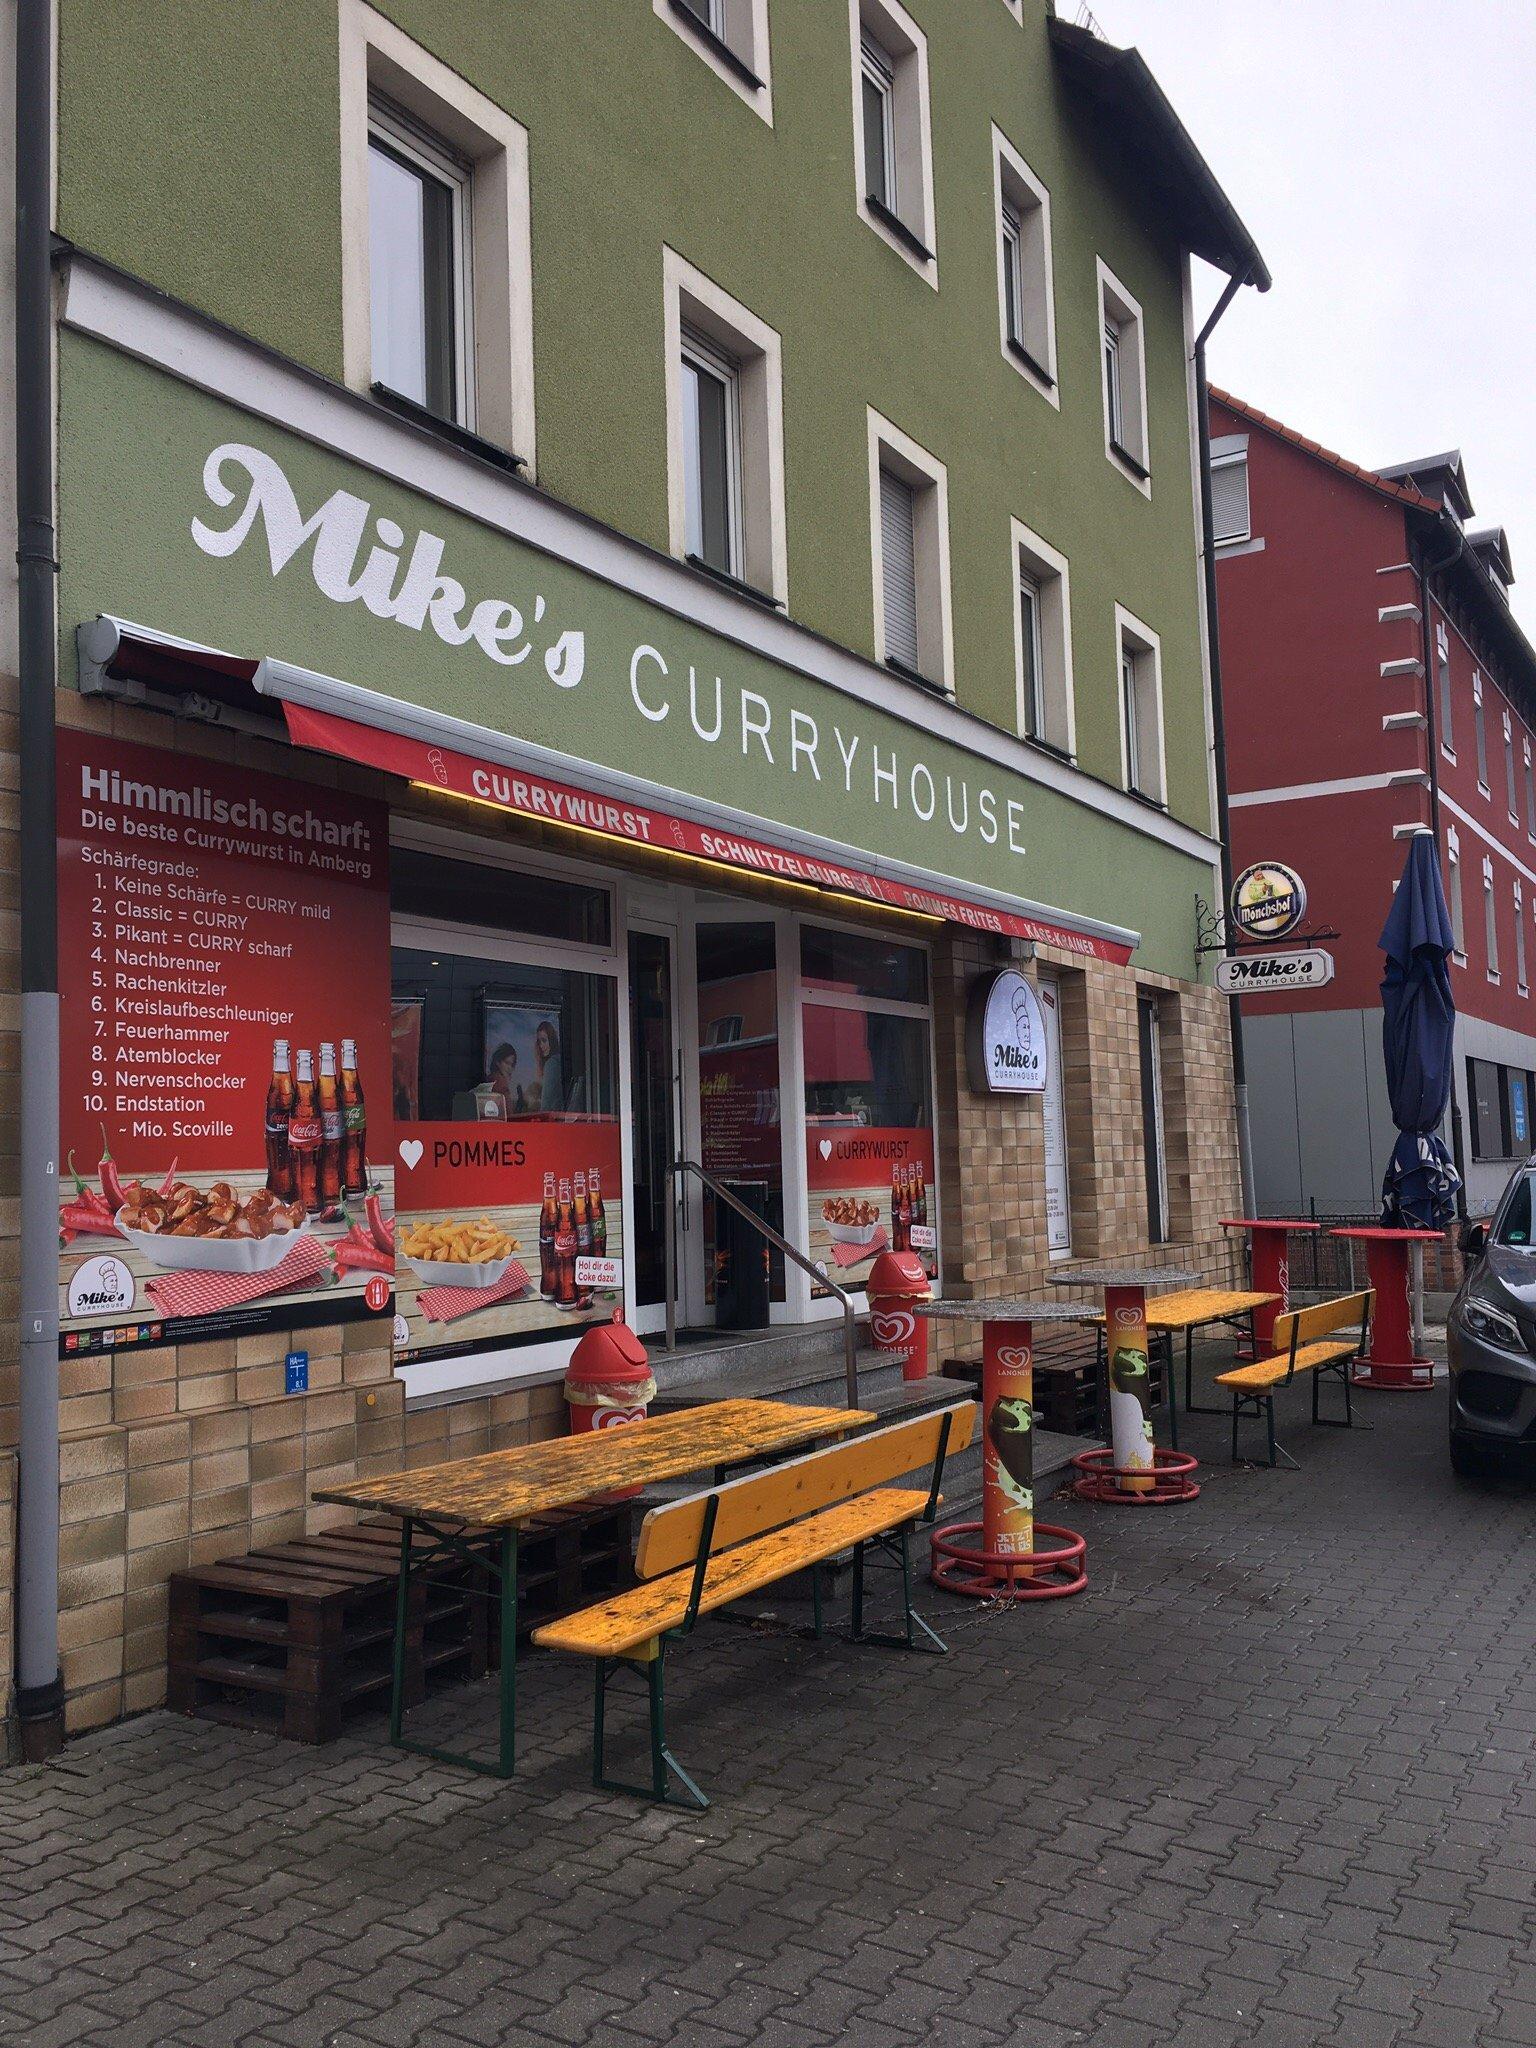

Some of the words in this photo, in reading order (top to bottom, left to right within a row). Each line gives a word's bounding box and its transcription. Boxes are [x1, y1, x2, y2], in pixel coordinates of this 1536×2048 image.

[191, 443, 585, 688] Mike's
[630, 644, 1026, 855] CURRYHOUSE
[81, 765, 268, 832] Himmlisch
[272, 810, 371, 851] scharf:
[81, 808, 117, 832] Die
[123, 815, 178, 842] beste
[184, 827, 283, 861] Currywurst
[288, 846, 303, 864] in
[308, 850, 371, 878] Amberg
[81, 846, 199, 879] Schärfegrade:
[472, 769, 651, 840] CURRYWURST
[700, 832, 875, 896] SCHNITZELBURGER
[903, 891, 958, 921] POMMES
[959, 907, 1002, 932] FRITES
[1023, 922, 1096, 956] KÄSE-KRAINER
[95, 873, 106, 889] 1.
[115, 876, 162, 897] Keine
[167, 883, 227, 906] Schärfe
[245, 894, 297, 915] CURRY
[301, 904, 331, 920] mild
[91, 897, 107, 914] 2.
[115, 900, 173, 921] Classic
[193, 910, 248, 930] CURRY
[91, 922, 107, 938] 3.
[115, 924, 168, 945] Pikant
[188, 933, 243, 954] CURRY
[248, 940, 293, 958] scharf
[91, 946, 107, 962] 4.
[115, 948, 221, 973] Nachbrenner
[1229, 959, 1313, 980] Mike's
[91, 971, 107, 987] 5.
[115, 973, 227, 997] Rachenkitzler
[1230, 975, 1312, 988] CURRYHOUSE
[91, 996, 107, 1012] 6.
[115, 998, 294, 1025] Kreislaufbeschleuniger
[94, 1021, 107, 1037] 7.
[115, 1022, 230, 1043] Feuerhammer
[91, 1046, 107, 1062] 8.
[115, 1046, 221, 1065] Atemblocker
[993, 1044, 1039, 1069] Mike's
[92, 1070, 108, 1086] 9.
[115, 1071, 246, 1089] Nervenschocker
[994, 1070, 1039, 1080] CURRYHOUSE
[83, 1095, 108, 1111] 10.
[116, 1096, 205, 1112] Endstation
[133, 1122, 167, 1137] Mio.
[172, 1121, 234, 1137] Scoville
[434, 1140, 526, 1168] POMMES
[836, 1141, 910, 1160] CURRYWURST
[578, 1261, 591, 1270] Hol
[592, 1261, 603, 1270] dir
[603, 1262, 615, 1271] die
[578, 1272, 596, 1281] Coke
[597, 1273, 617, 1283] dazu!
[76, 1291, 125, 1306] Mike's
[77, 1301, 124, 1312] CURRYHOUSE
